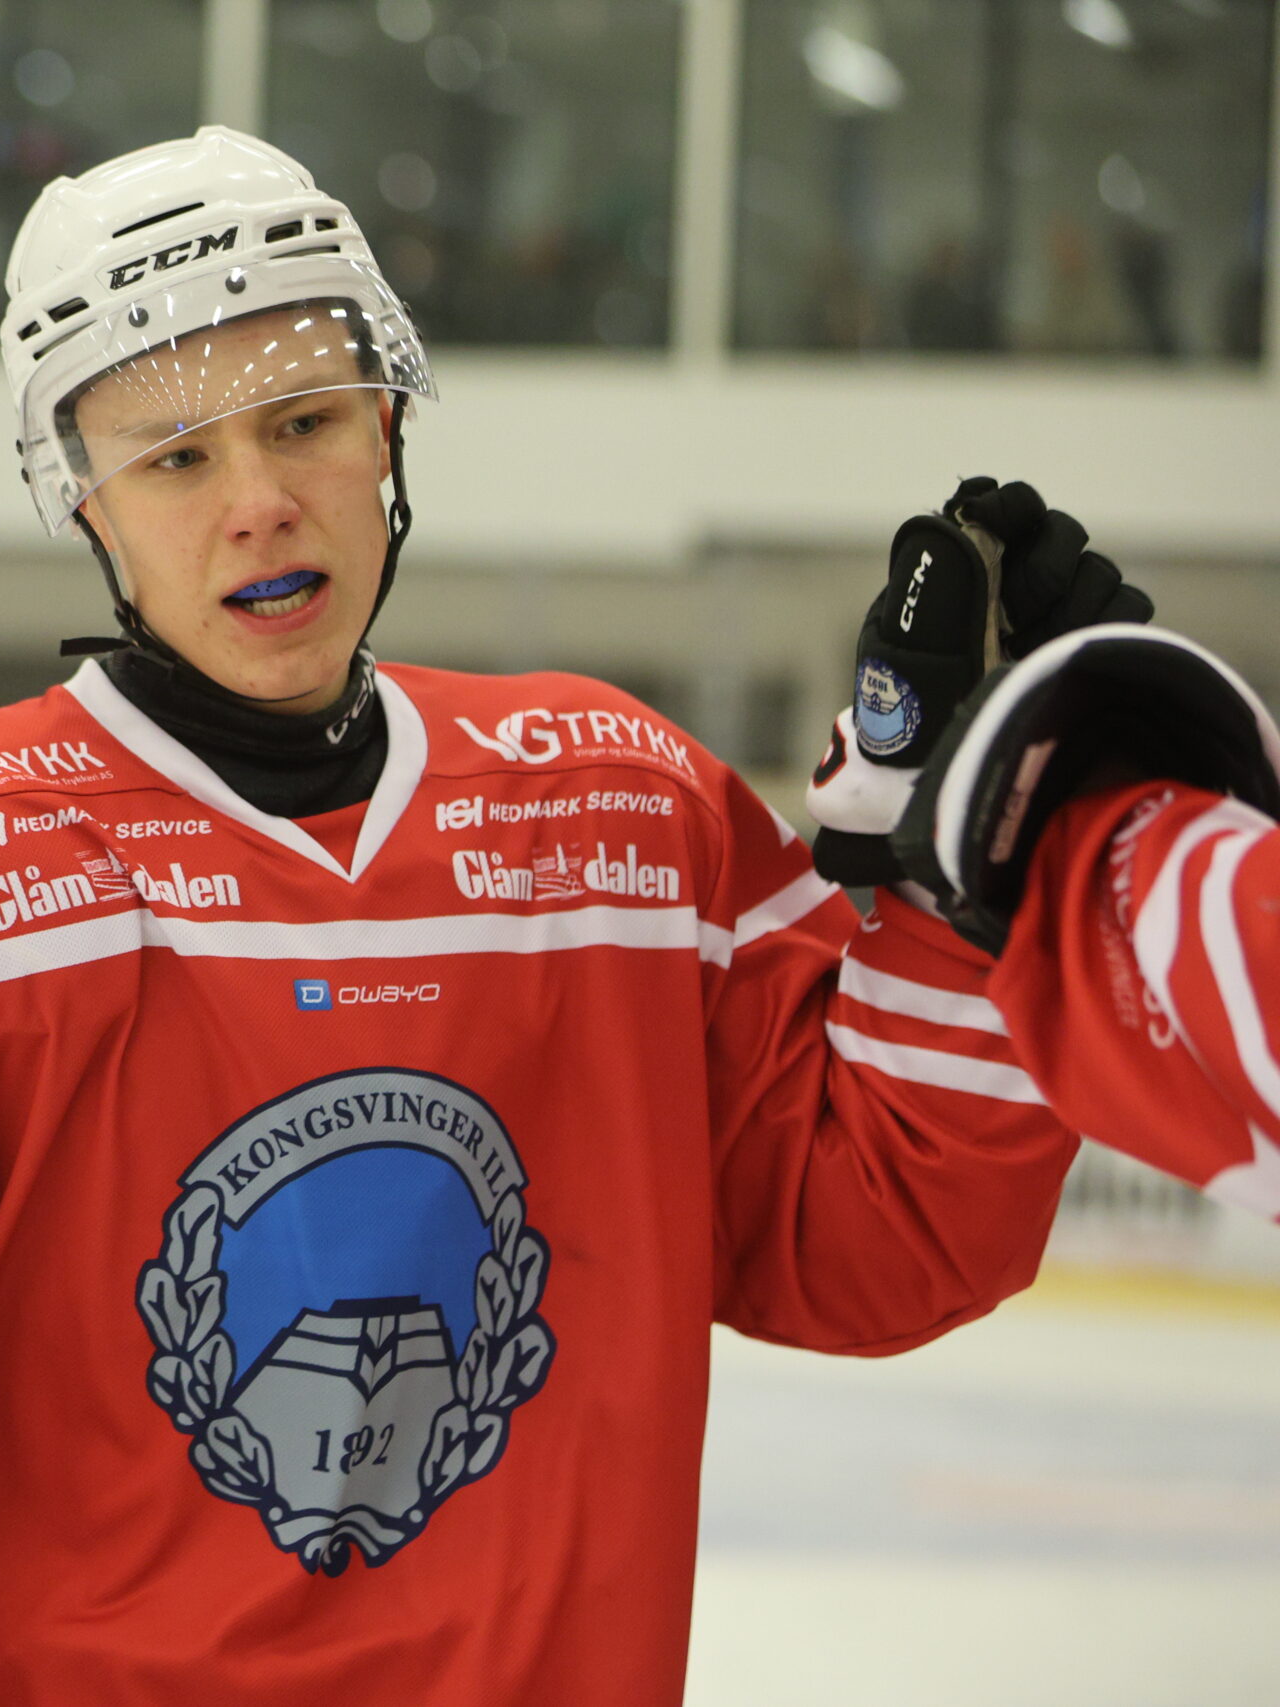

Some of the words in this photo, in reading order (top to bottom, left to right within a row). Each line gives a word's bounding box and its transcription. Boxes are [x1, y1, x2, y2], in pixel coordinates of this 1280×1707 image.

[107, 226, 239, 290] CCM
[900, 549, 933, 632] CCM
[13, 806, 110, 834] HEDMA
[115, 819, 212, 839] SERVICE
[488, 796, 581, 823] HEDMARK
[586, 790, 673, 816] SERVICE
[217, 1091, 484, 1196] KONGSVINGER
[480, 1146, 505, 1198] IL
[312, 1423, 395, 1475] 1892
